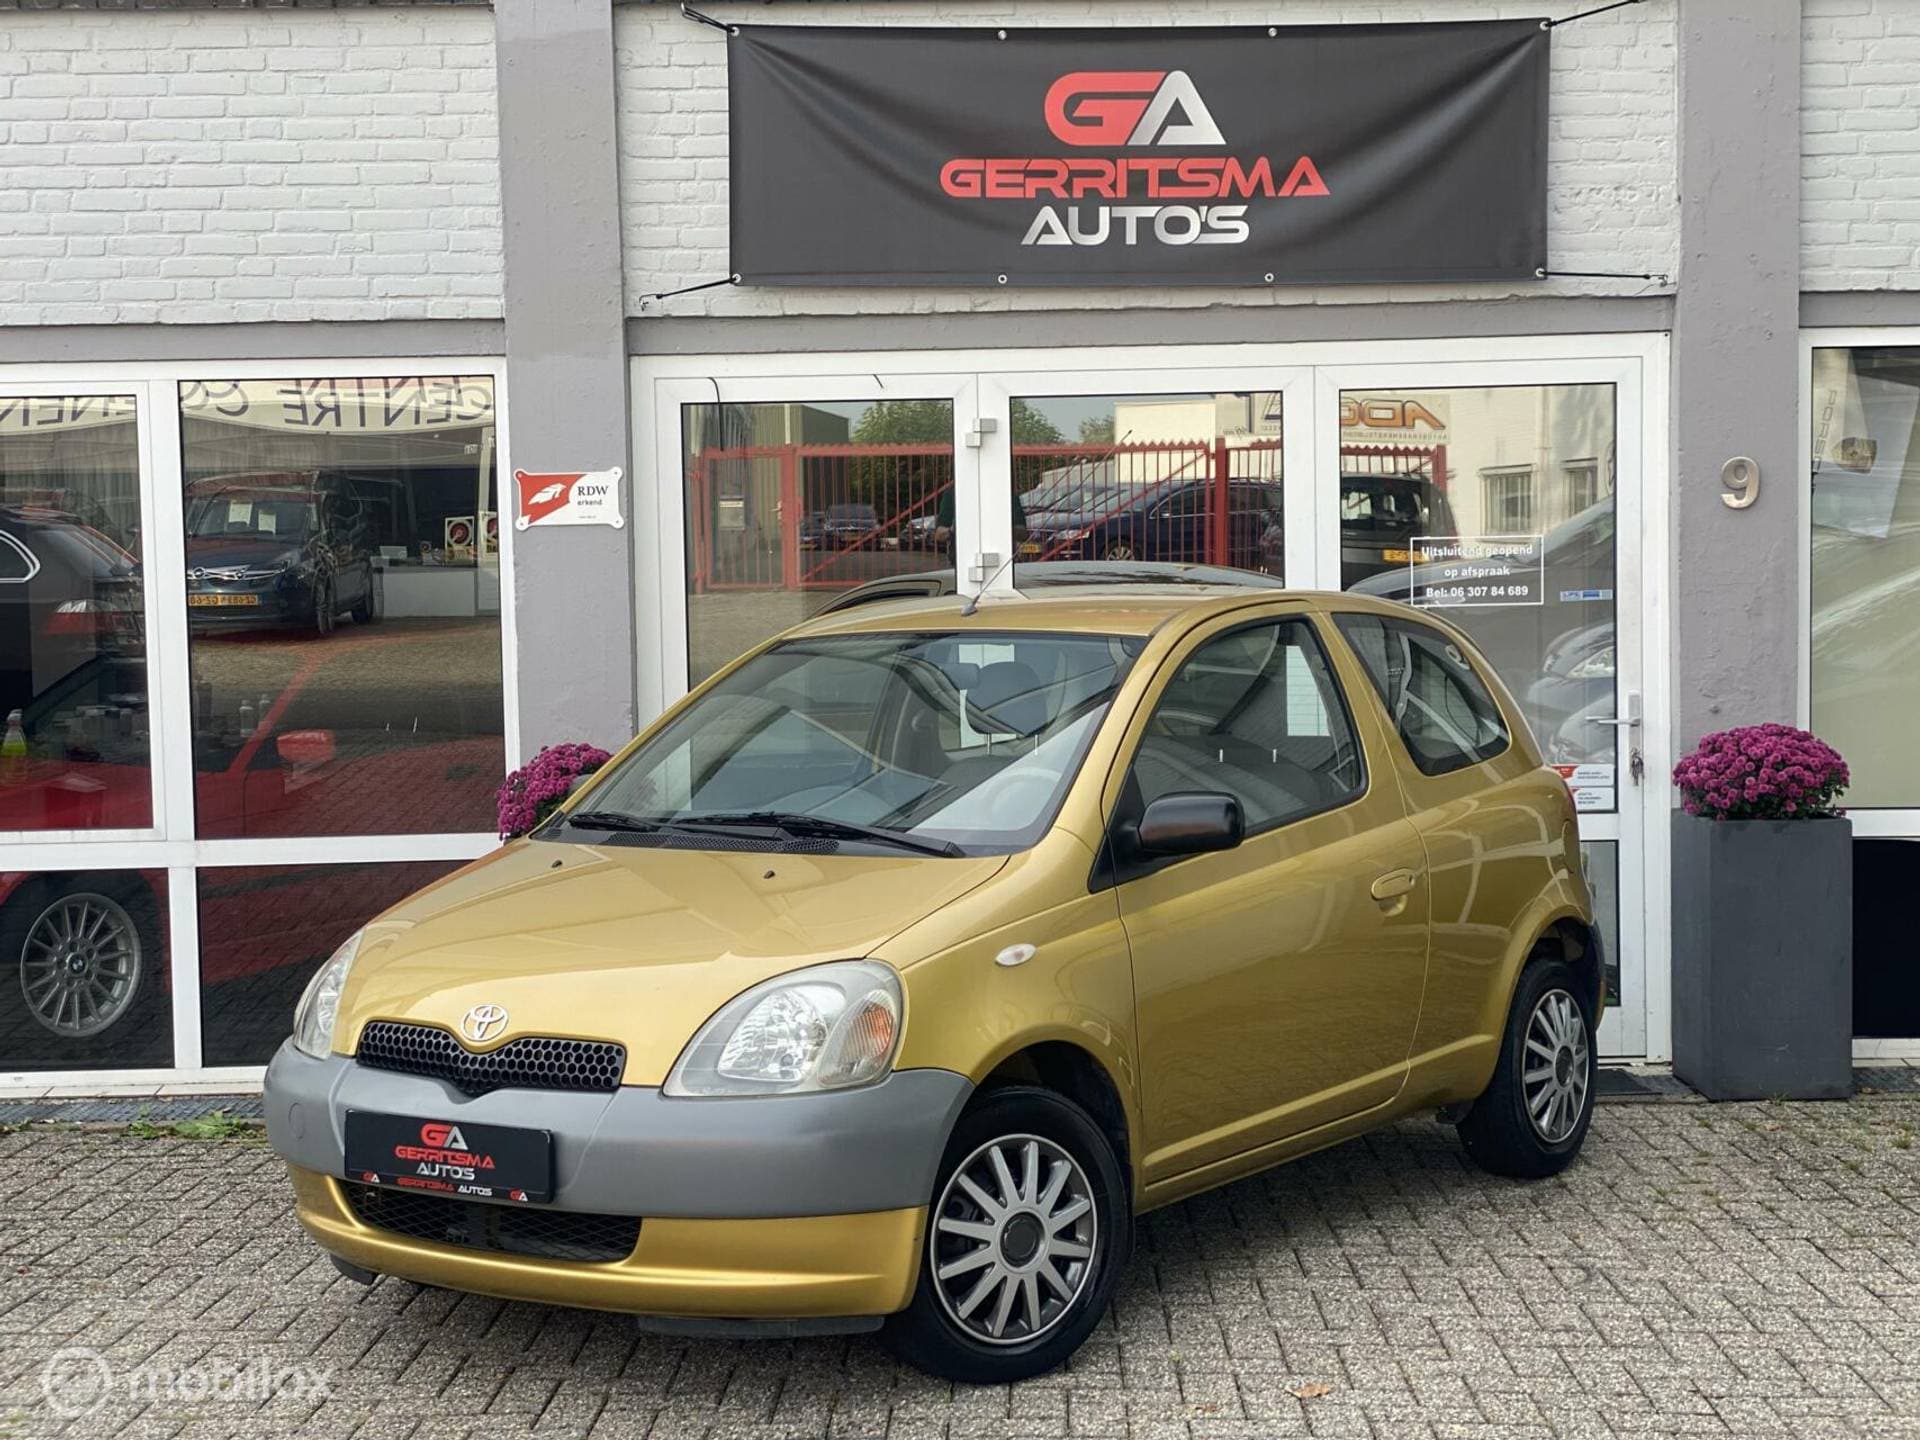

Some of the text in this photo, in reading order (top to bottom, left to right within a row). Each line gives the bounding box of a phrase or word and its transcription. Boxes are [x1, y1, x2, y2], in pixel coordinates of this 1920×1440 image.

[1044, 70, 1227, 146] GA
[939, 156, 1331, 198] GERRITSMA
[1021, 205, 1249, 245] AUTO'S
[577, 485, 609, 496] RDW
[1720, 455, 1761, 510] 9
[1421, 545, 1482, 557] Uitsluitend
[1486, 544, 1533, 560] geopend
[1444, 565, 1511, 578] op afspraak
[1426, 584, 1529, 598] Bel: 06 307 84 689
[420, 1123, 468, 1150] GA
[394, 1146, 496, 1169] GERRITSMA
[396, 1177, 455, 1193] GERRITSMA
